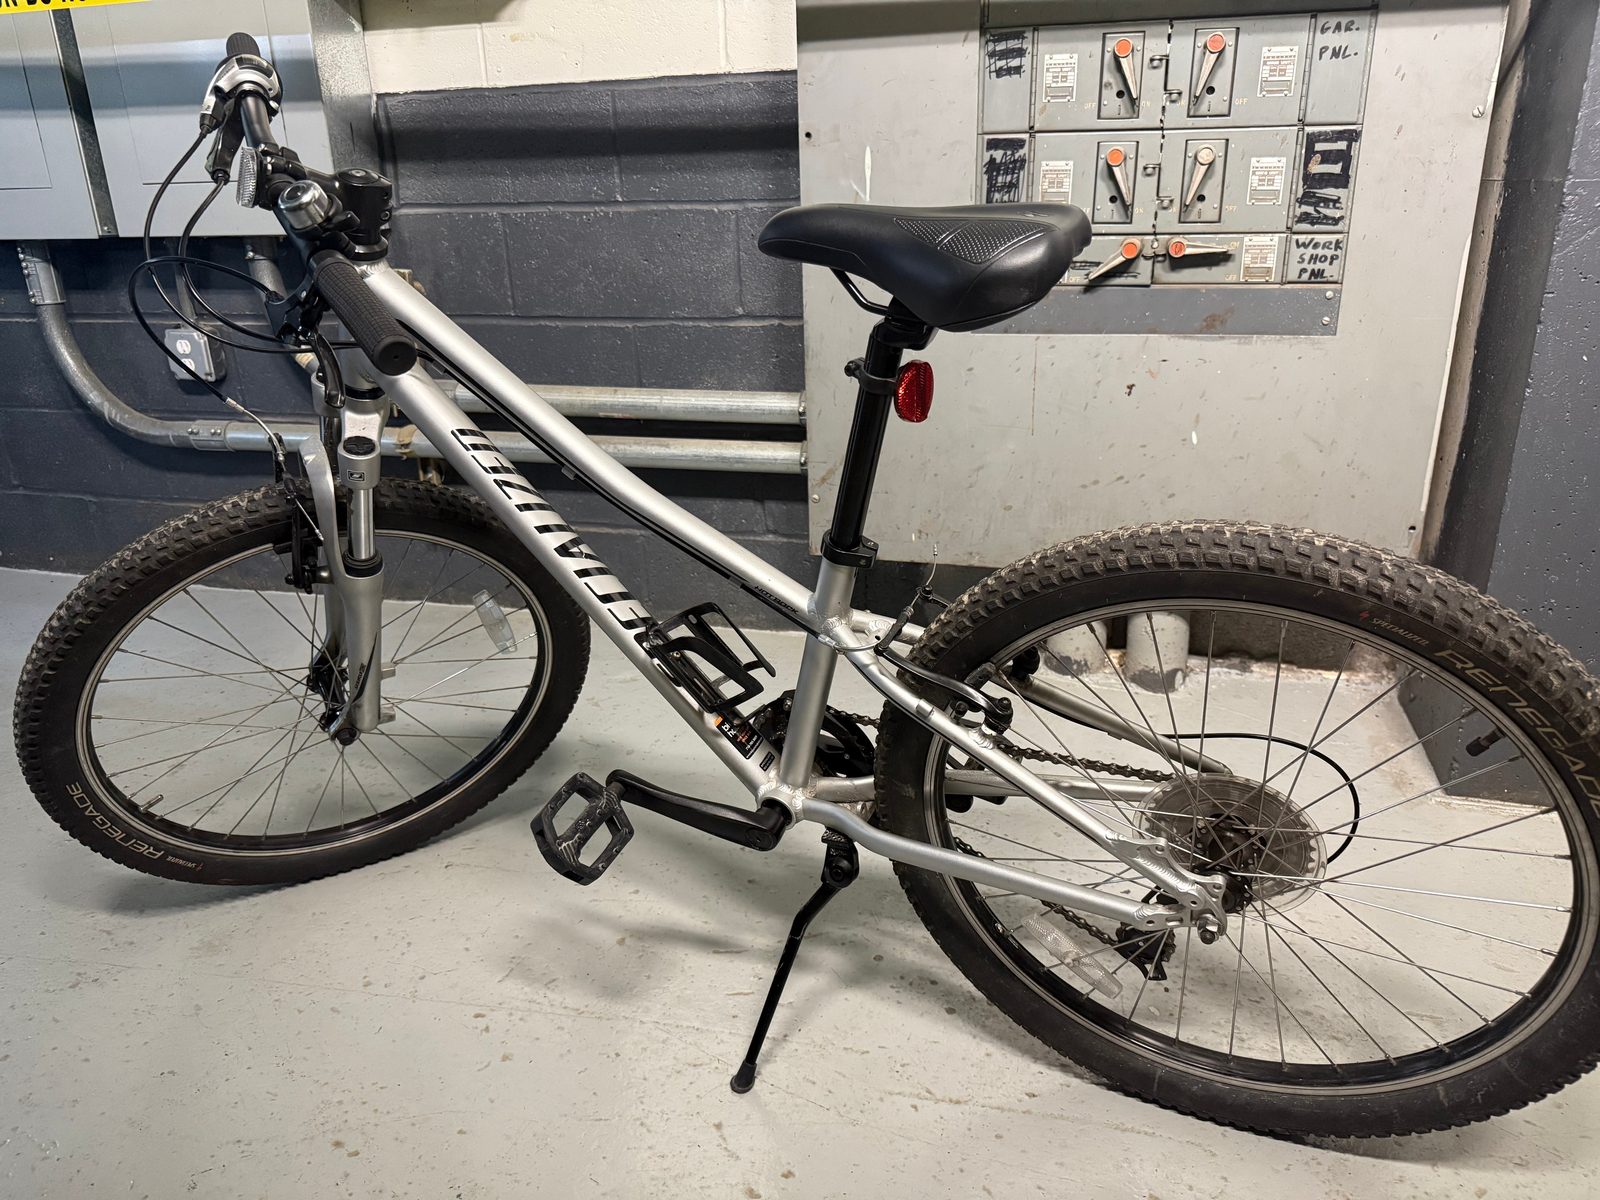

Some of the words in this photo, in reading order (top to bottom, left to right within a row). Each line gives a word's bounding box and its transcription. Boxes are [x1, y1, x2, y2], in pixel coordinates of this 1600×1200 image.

[1320, 19, 1360, 35] GAR.
[1319, 44, 1358, 61] PNL.
[1235, 97, 1249, 105] OFF
[1295, 237, 1343, 252] WORK
[1297, 253, 1339, 266] SHOP
[65, 782, 165, 860] RENEGADE
